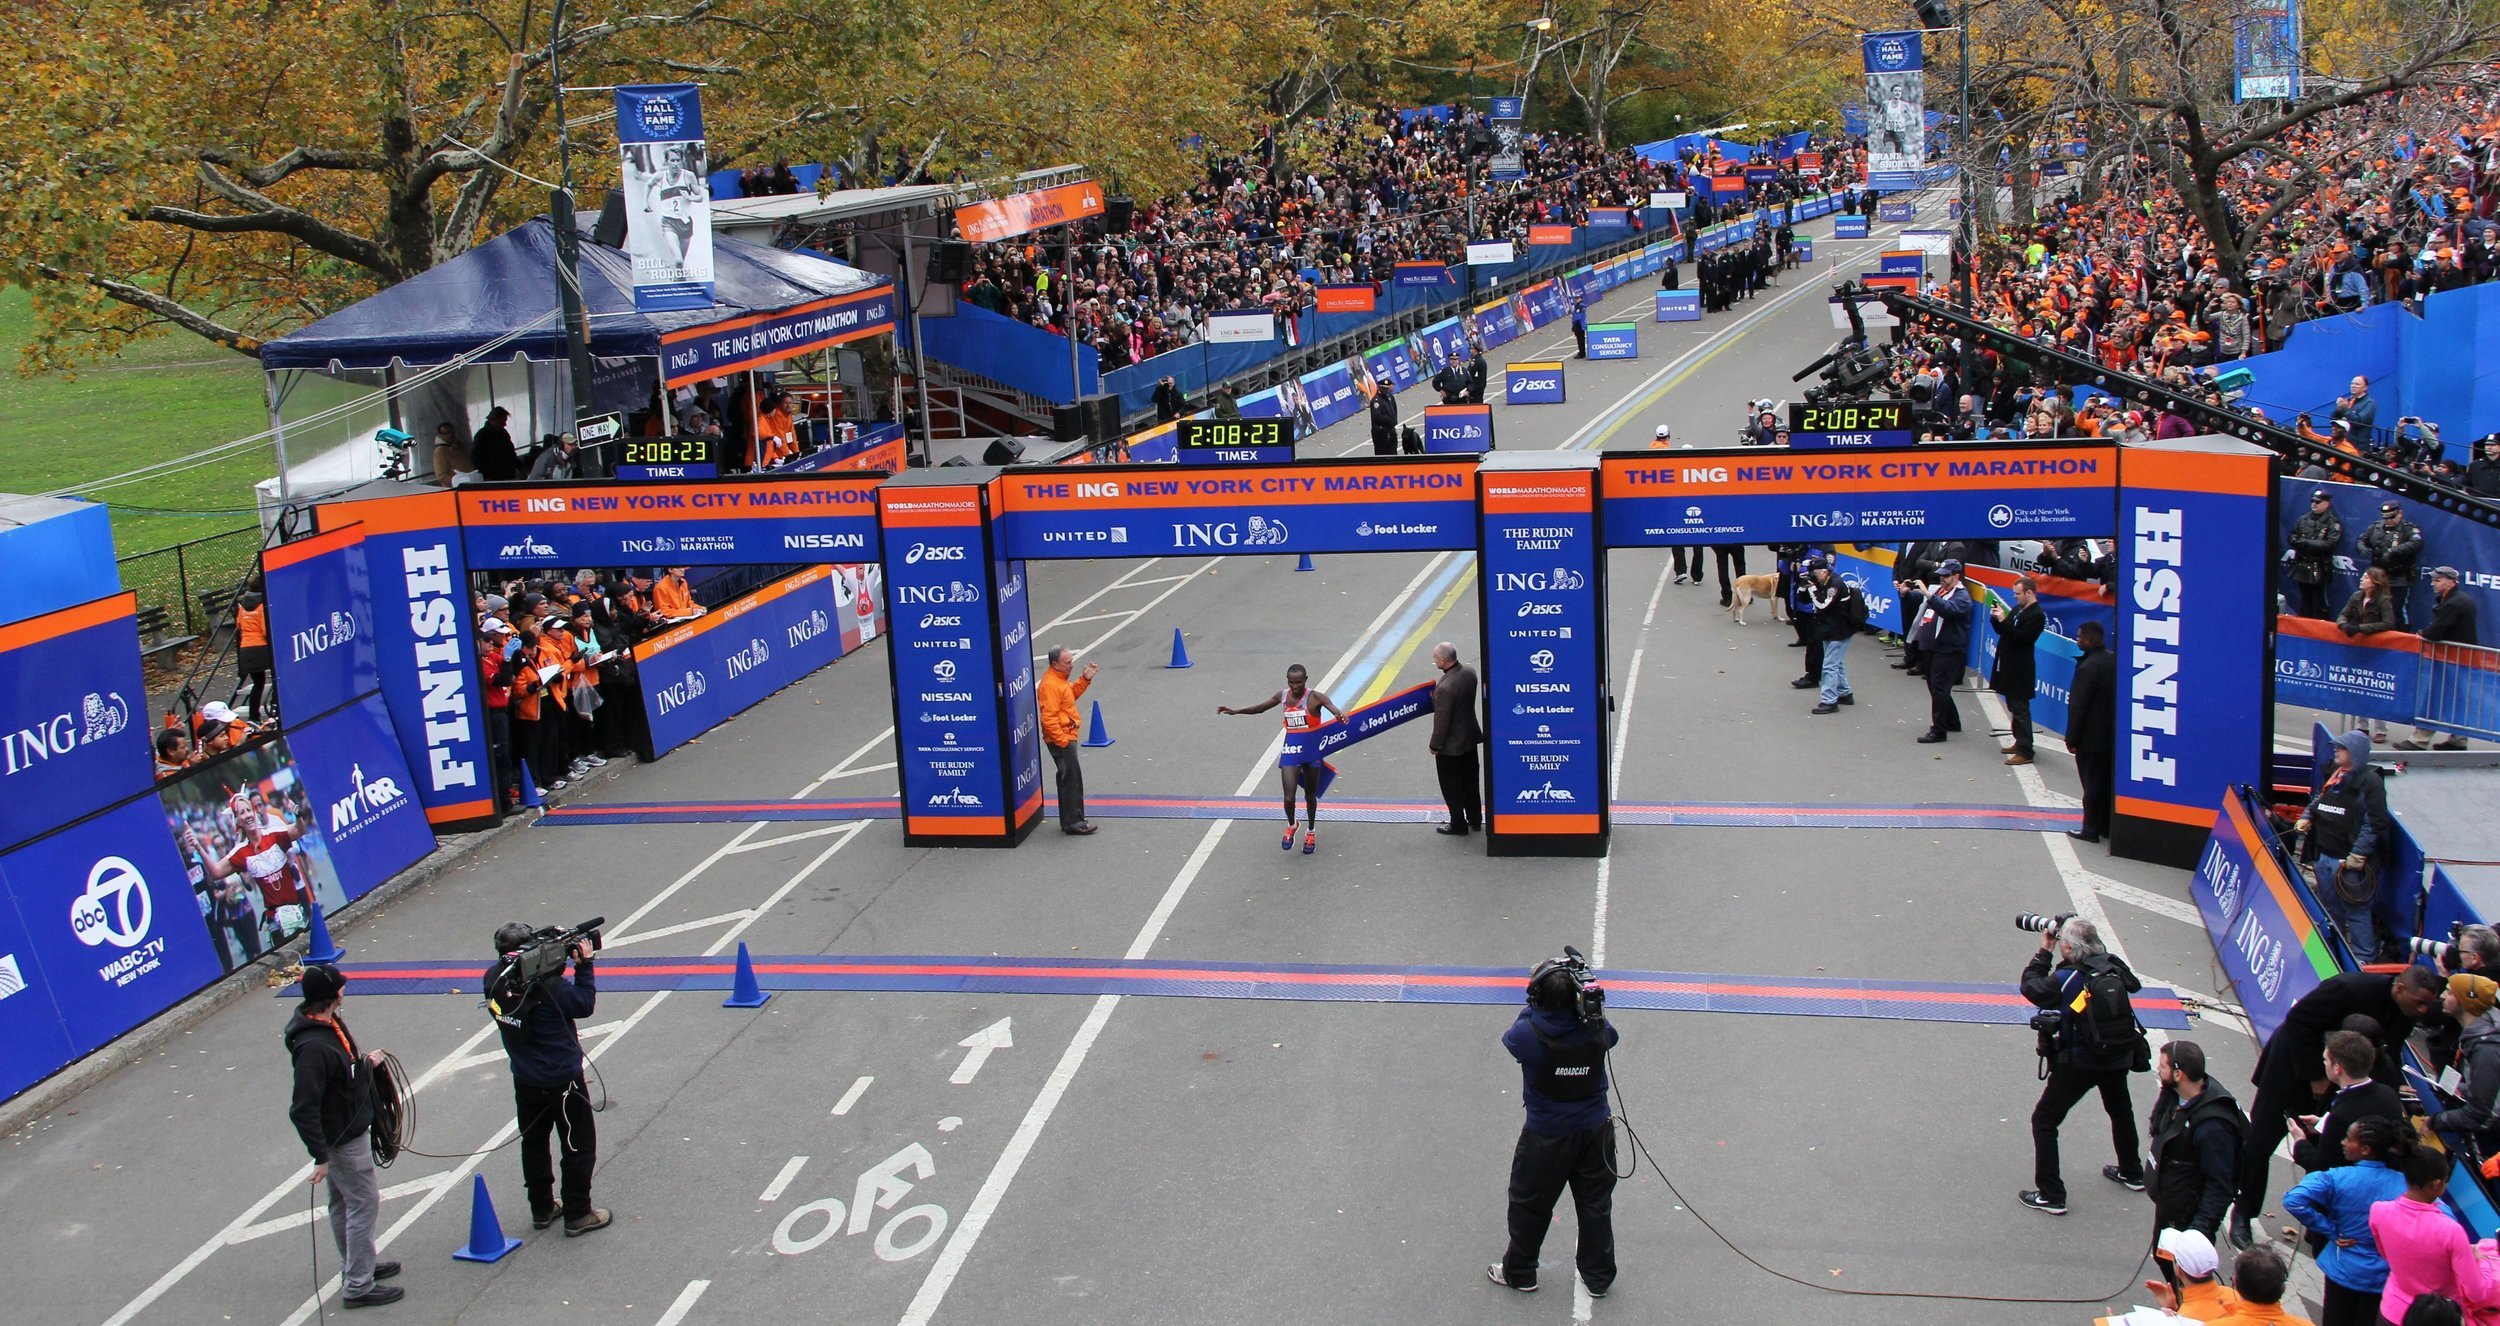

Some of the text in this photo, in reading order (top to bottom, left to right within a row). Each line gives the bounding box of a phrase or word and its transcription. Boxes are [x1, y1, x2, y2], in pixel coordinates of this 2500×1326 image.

[644, 105, 674, 113] HALL
[646, 116, 675, 124] FAME
[866, 309, 877, 321] ING
[712, 310, 858, 359] THE ING NEW YORK CITY MARATHON
[1600, 343, 1632, 351] CONSULTANCY
[672, 354, 687, 369] ING
[1526, 378, 1555, 390] asics
[1334, 386, 1352, 401] NISSAN
[1311, 395, 1330, 411] NISSAN
[582, 422, 610, 439] ONE WAY
[1432, 428, 1460, 440] ING
[1827, 434, 1872, 445] TIMEX
[1216, 450, 1258, 461] TIMEX
[646, 468, 685, 477] TIMEX
[1625, 459, 2097, 484] THE ING NEW YORK CITY MARATHON
[1024, 474, 1462, 498] THE ING NEW YORK CITY MARATHON
[480, 490, 876, 512] THE ING NEW YORK CITY MARATHON
[1791, 514, 1827, 527] ING
[2014, 509, 2030, 517] City
[1375, 524, 1437, 534] Foot Locker
[1862, 517, 1925, 526] MARATHON
[1043, 532, 1107, 542] UNITED
[1172, 523, 1238, 547] ING
[1503, 528, 1574, 538] THE RUDIN
[500, 542, 557, 555] NYRR
[622, 540, 653, 552] ING
[681, 542, 734, 550] MARATHON
[784, 534, 864, 548] NISSAN
[1517, 540, 1561, 550] FAMILY
[925, 547, 964, 560] asics
[1496, 573, 1547, 591] ING
[898, 586, 945, 603] ING
[1000, 583, 1013, 603] ING
[1532, 604, 1562, 614] asics
[934, 616, 960, 626] asics
[788, 621, 811, 649] ING
[1005, 628, 1017, 650] ING
[292, 623, 329, 663] ING
[653, 641, 665, 652] ING
[2131, 507, 2182, 786] FINISH
[403, 544, 476, 791] FINISH
[726, 649, 752, 680] ING
[2329, 665, 2395, 680] NEW YORK CITY
[1009, 675, 1023, 698] ING
[1515, 684, 1570, 692] NISSAN
[2329, 672, 2394, 691] MARATHON
[657, 683, 686, 716] ING
[922, 693, 972, 702] NISSAN
[2366, 692, 2394, 700] RUNNERS
[1368, 702, 1418, 728] Foot Locker
[1013, 722, 1027, 744] ING
[1328, 730, 1347, 745] asics
[1, 712, 77, 776] ING
[1017, 768, 1030, 791] ING
[1517, 787, 1575, 799] NYRR
[331, 772, 404, 832] NYRR
[2317, 803, 2346, 815] BROADCAST
[335, 798, 408, 843] NEW YORK ROAD RUNNERS
[2203, 840, 2230, 897] ING
[74, 907, 104, 933] abc
[2236, 908, 2270, 975] ING
[99, 937, 164, 981] WABC-TV
[117, 958, 161, 987] NEW YORK
[1554, 1065, 1590, 1077] BROADCAST
